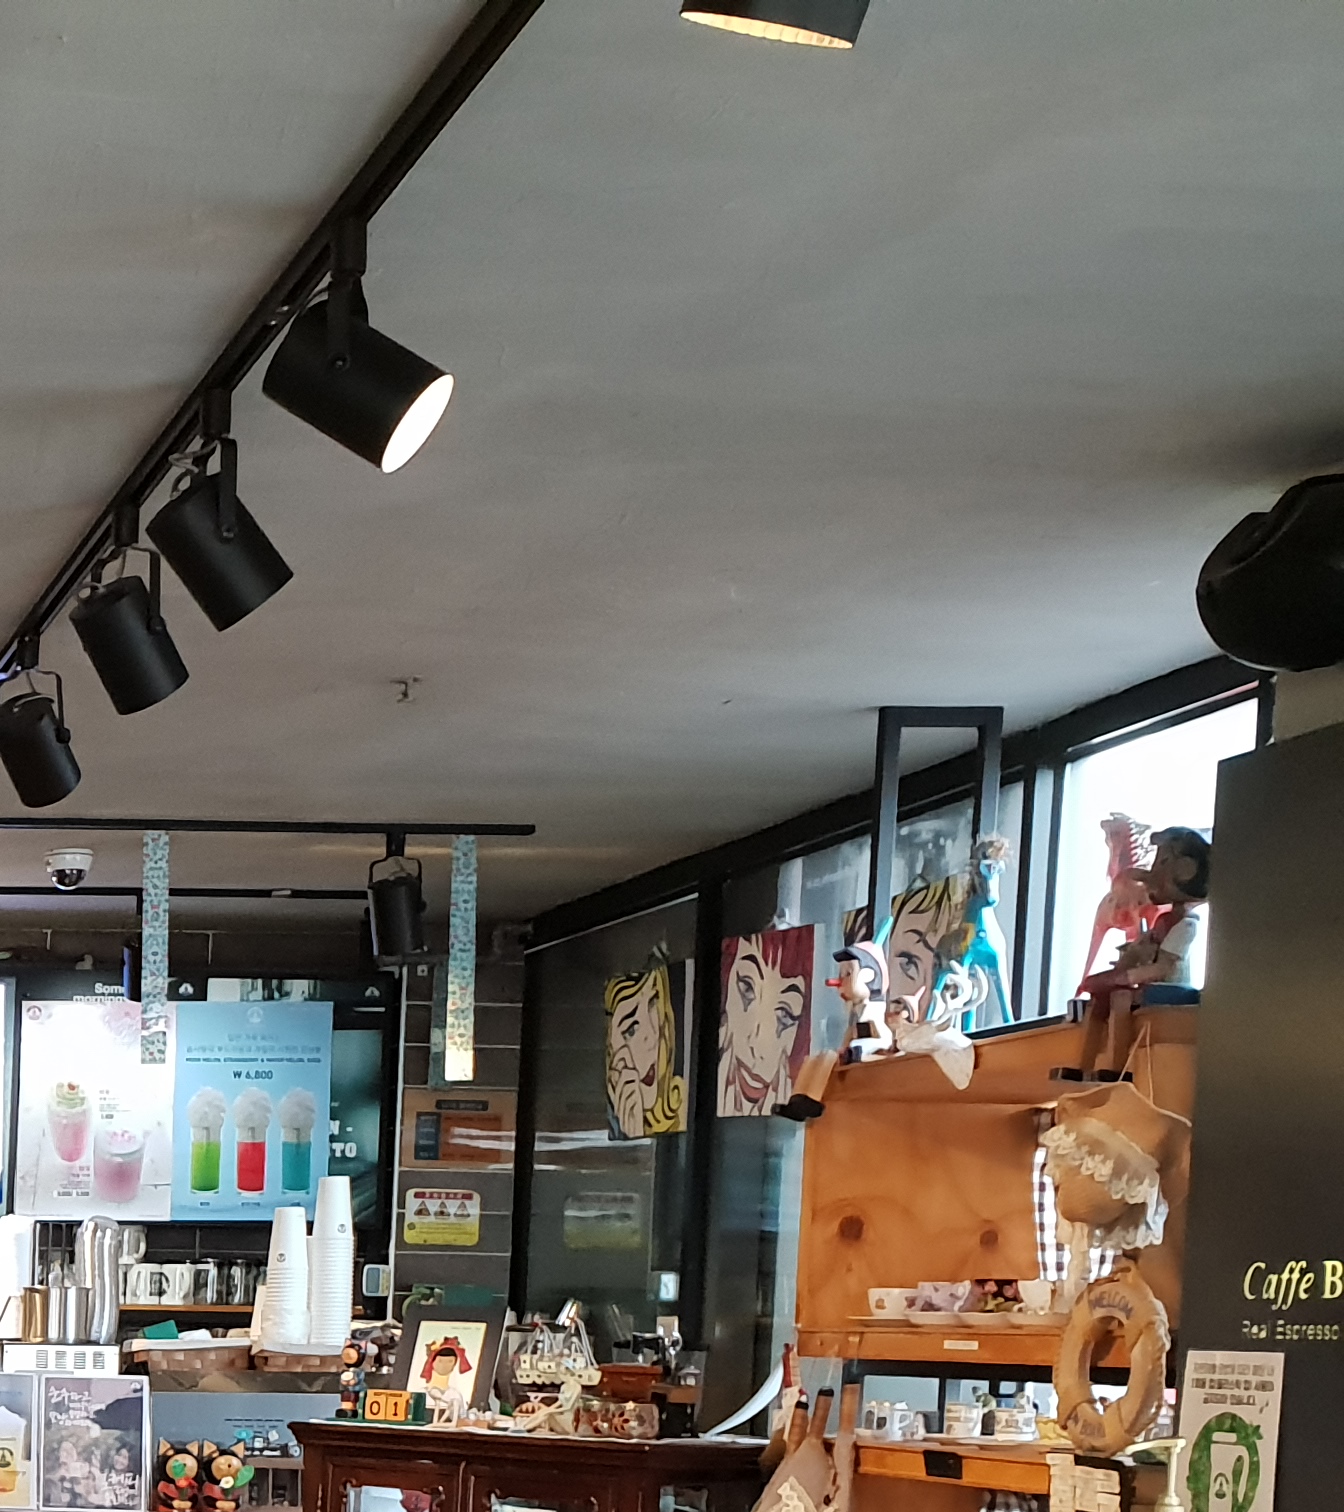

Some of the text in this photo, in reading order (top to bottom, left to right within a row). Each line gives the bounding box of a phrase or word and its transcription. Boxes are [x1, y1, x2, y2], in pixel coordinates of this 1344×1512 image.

[245, 1070, 273, 1080] 6,800
[1242, 1260, 1315, 1311] Caffe
[1242, 1320, 1340, 1341] Real Espresso
